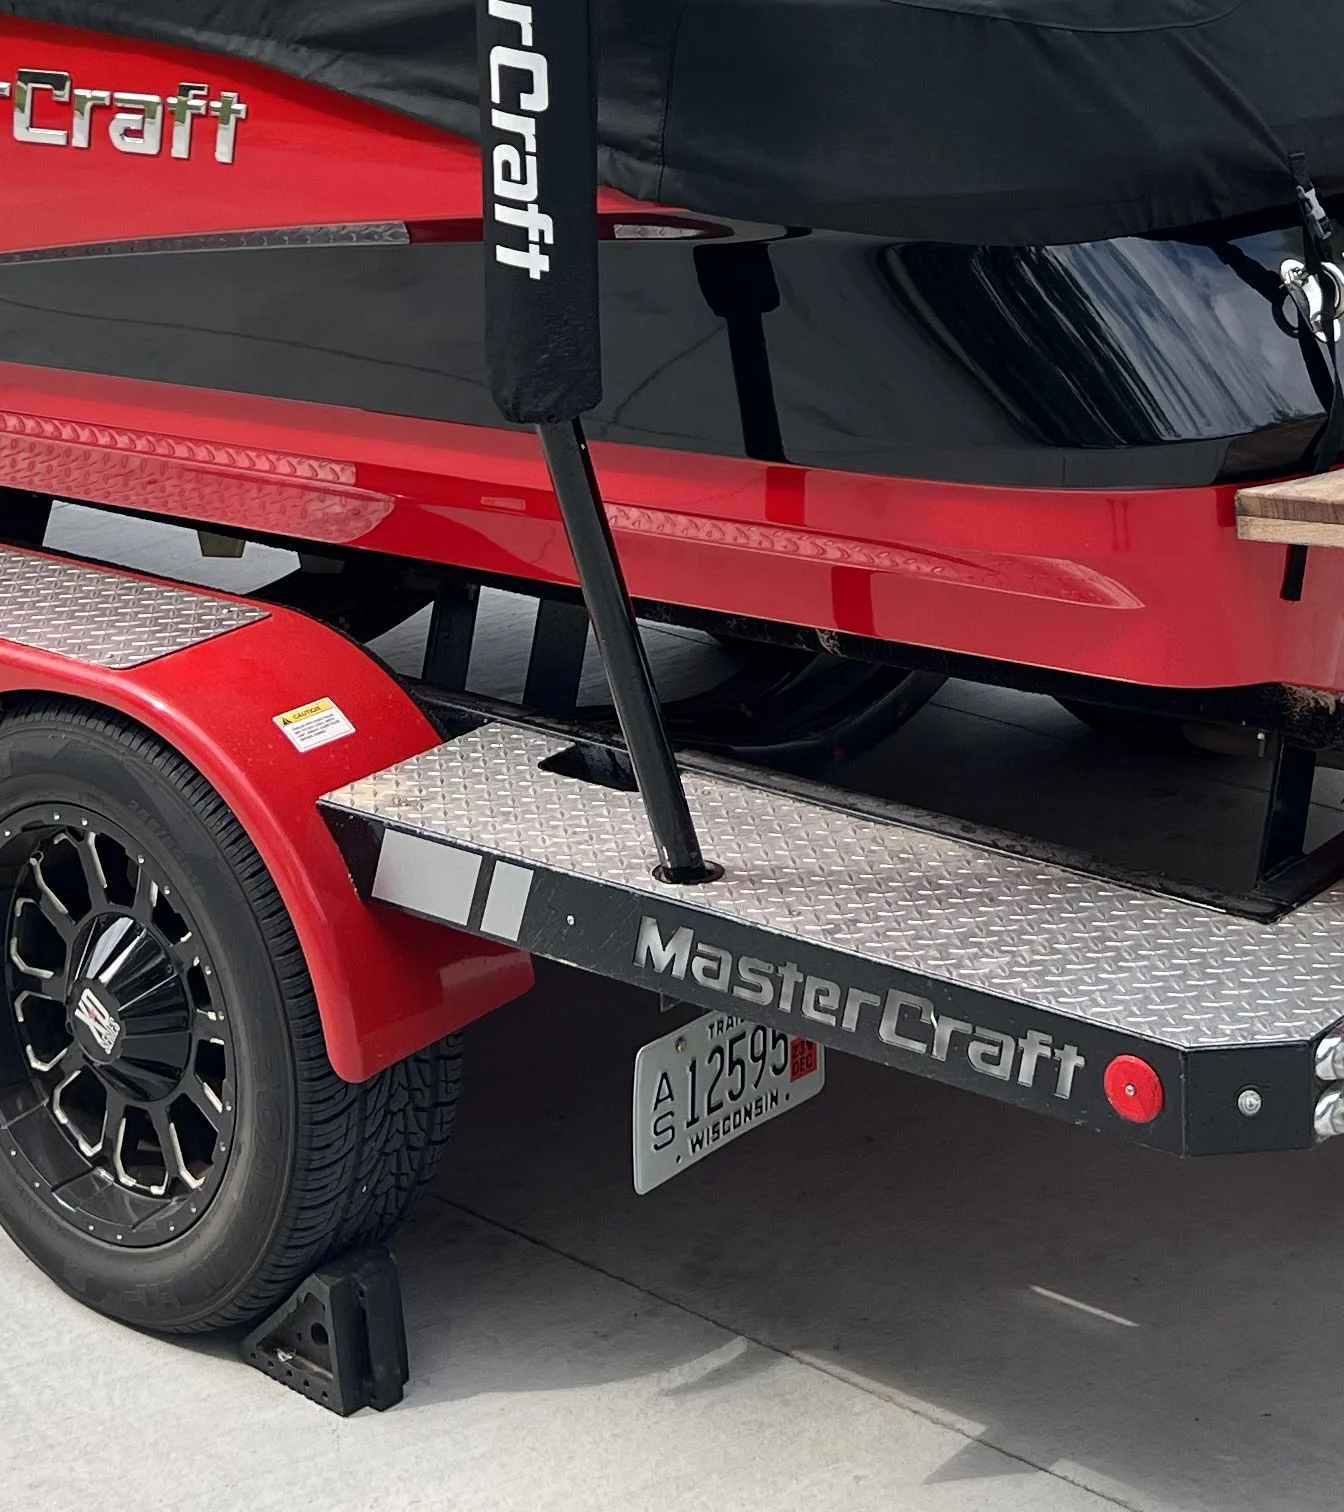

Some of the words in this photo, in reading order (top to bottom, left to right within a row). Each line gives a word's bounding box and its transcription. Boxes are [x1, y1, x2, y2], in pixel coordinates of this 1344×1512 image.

[293, 705, 322, 720] CAUTION
[633, 916, 1086, 1099] MasterCraft
[708, 1015, 744, 1039] TRAI
[686, 1024, 789, 1129] 12595
[691, 1089, 779, 1155] WISCONSIN
